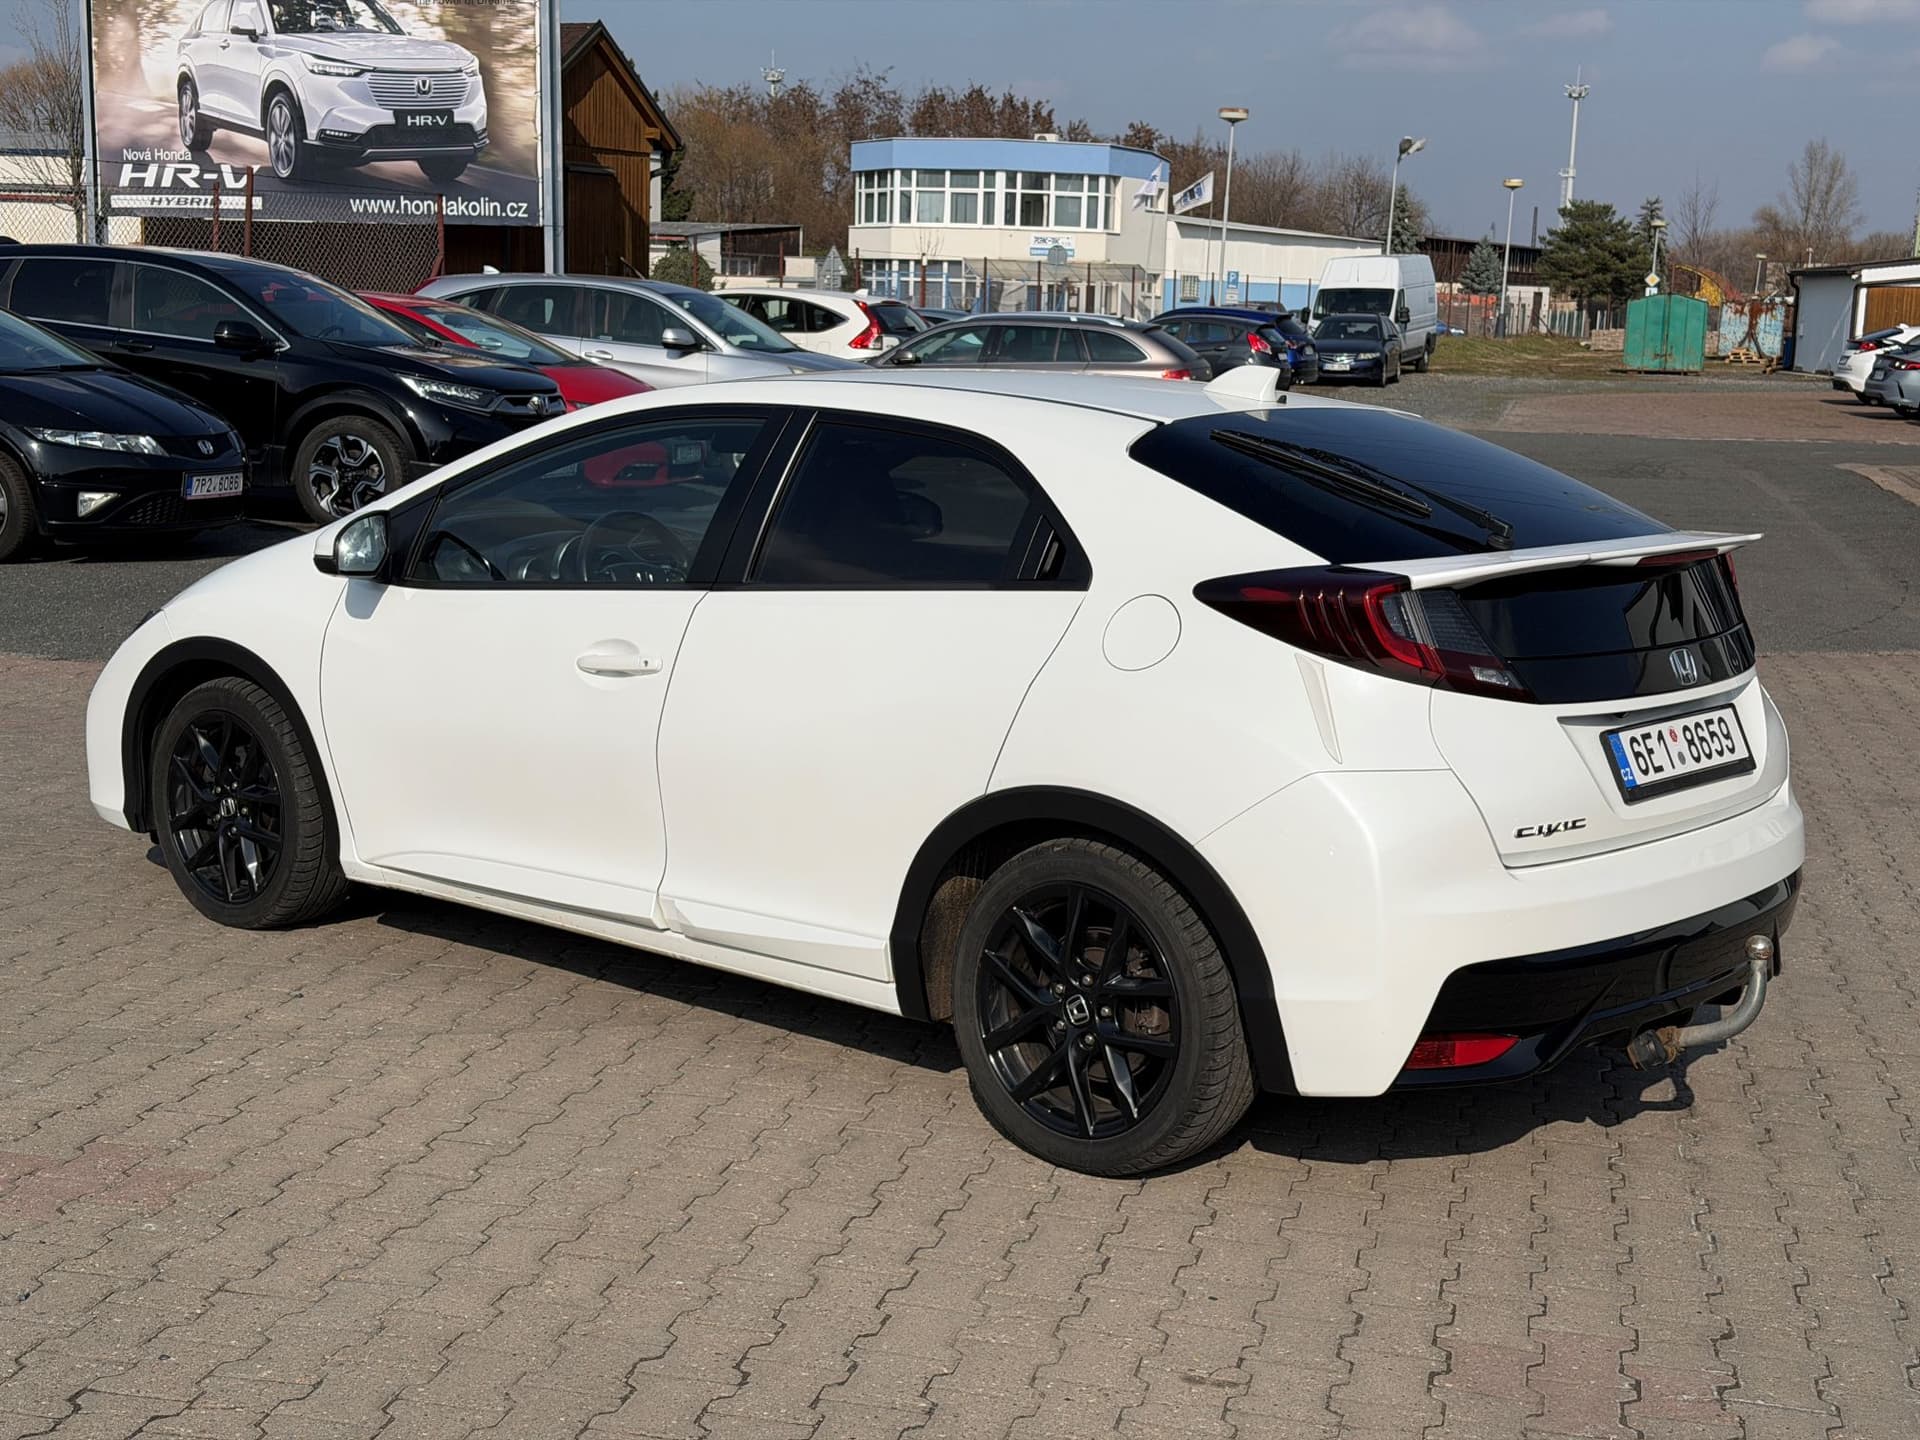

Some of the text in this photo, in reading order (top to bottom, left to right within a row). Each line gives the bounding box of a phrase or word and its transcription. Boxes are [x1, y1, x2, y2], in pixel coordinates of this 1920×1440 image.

[407, 115, 448, 126] HR-V
[123, 148, 192, 161] Nová Honda
[119, 163, 261, 189] HR-V
[1629, 716, 1736, 776] 6E1 8659
[1620, 768, 1633, 781] CZ
[1514, 817, 1587, 839] CIVIC
